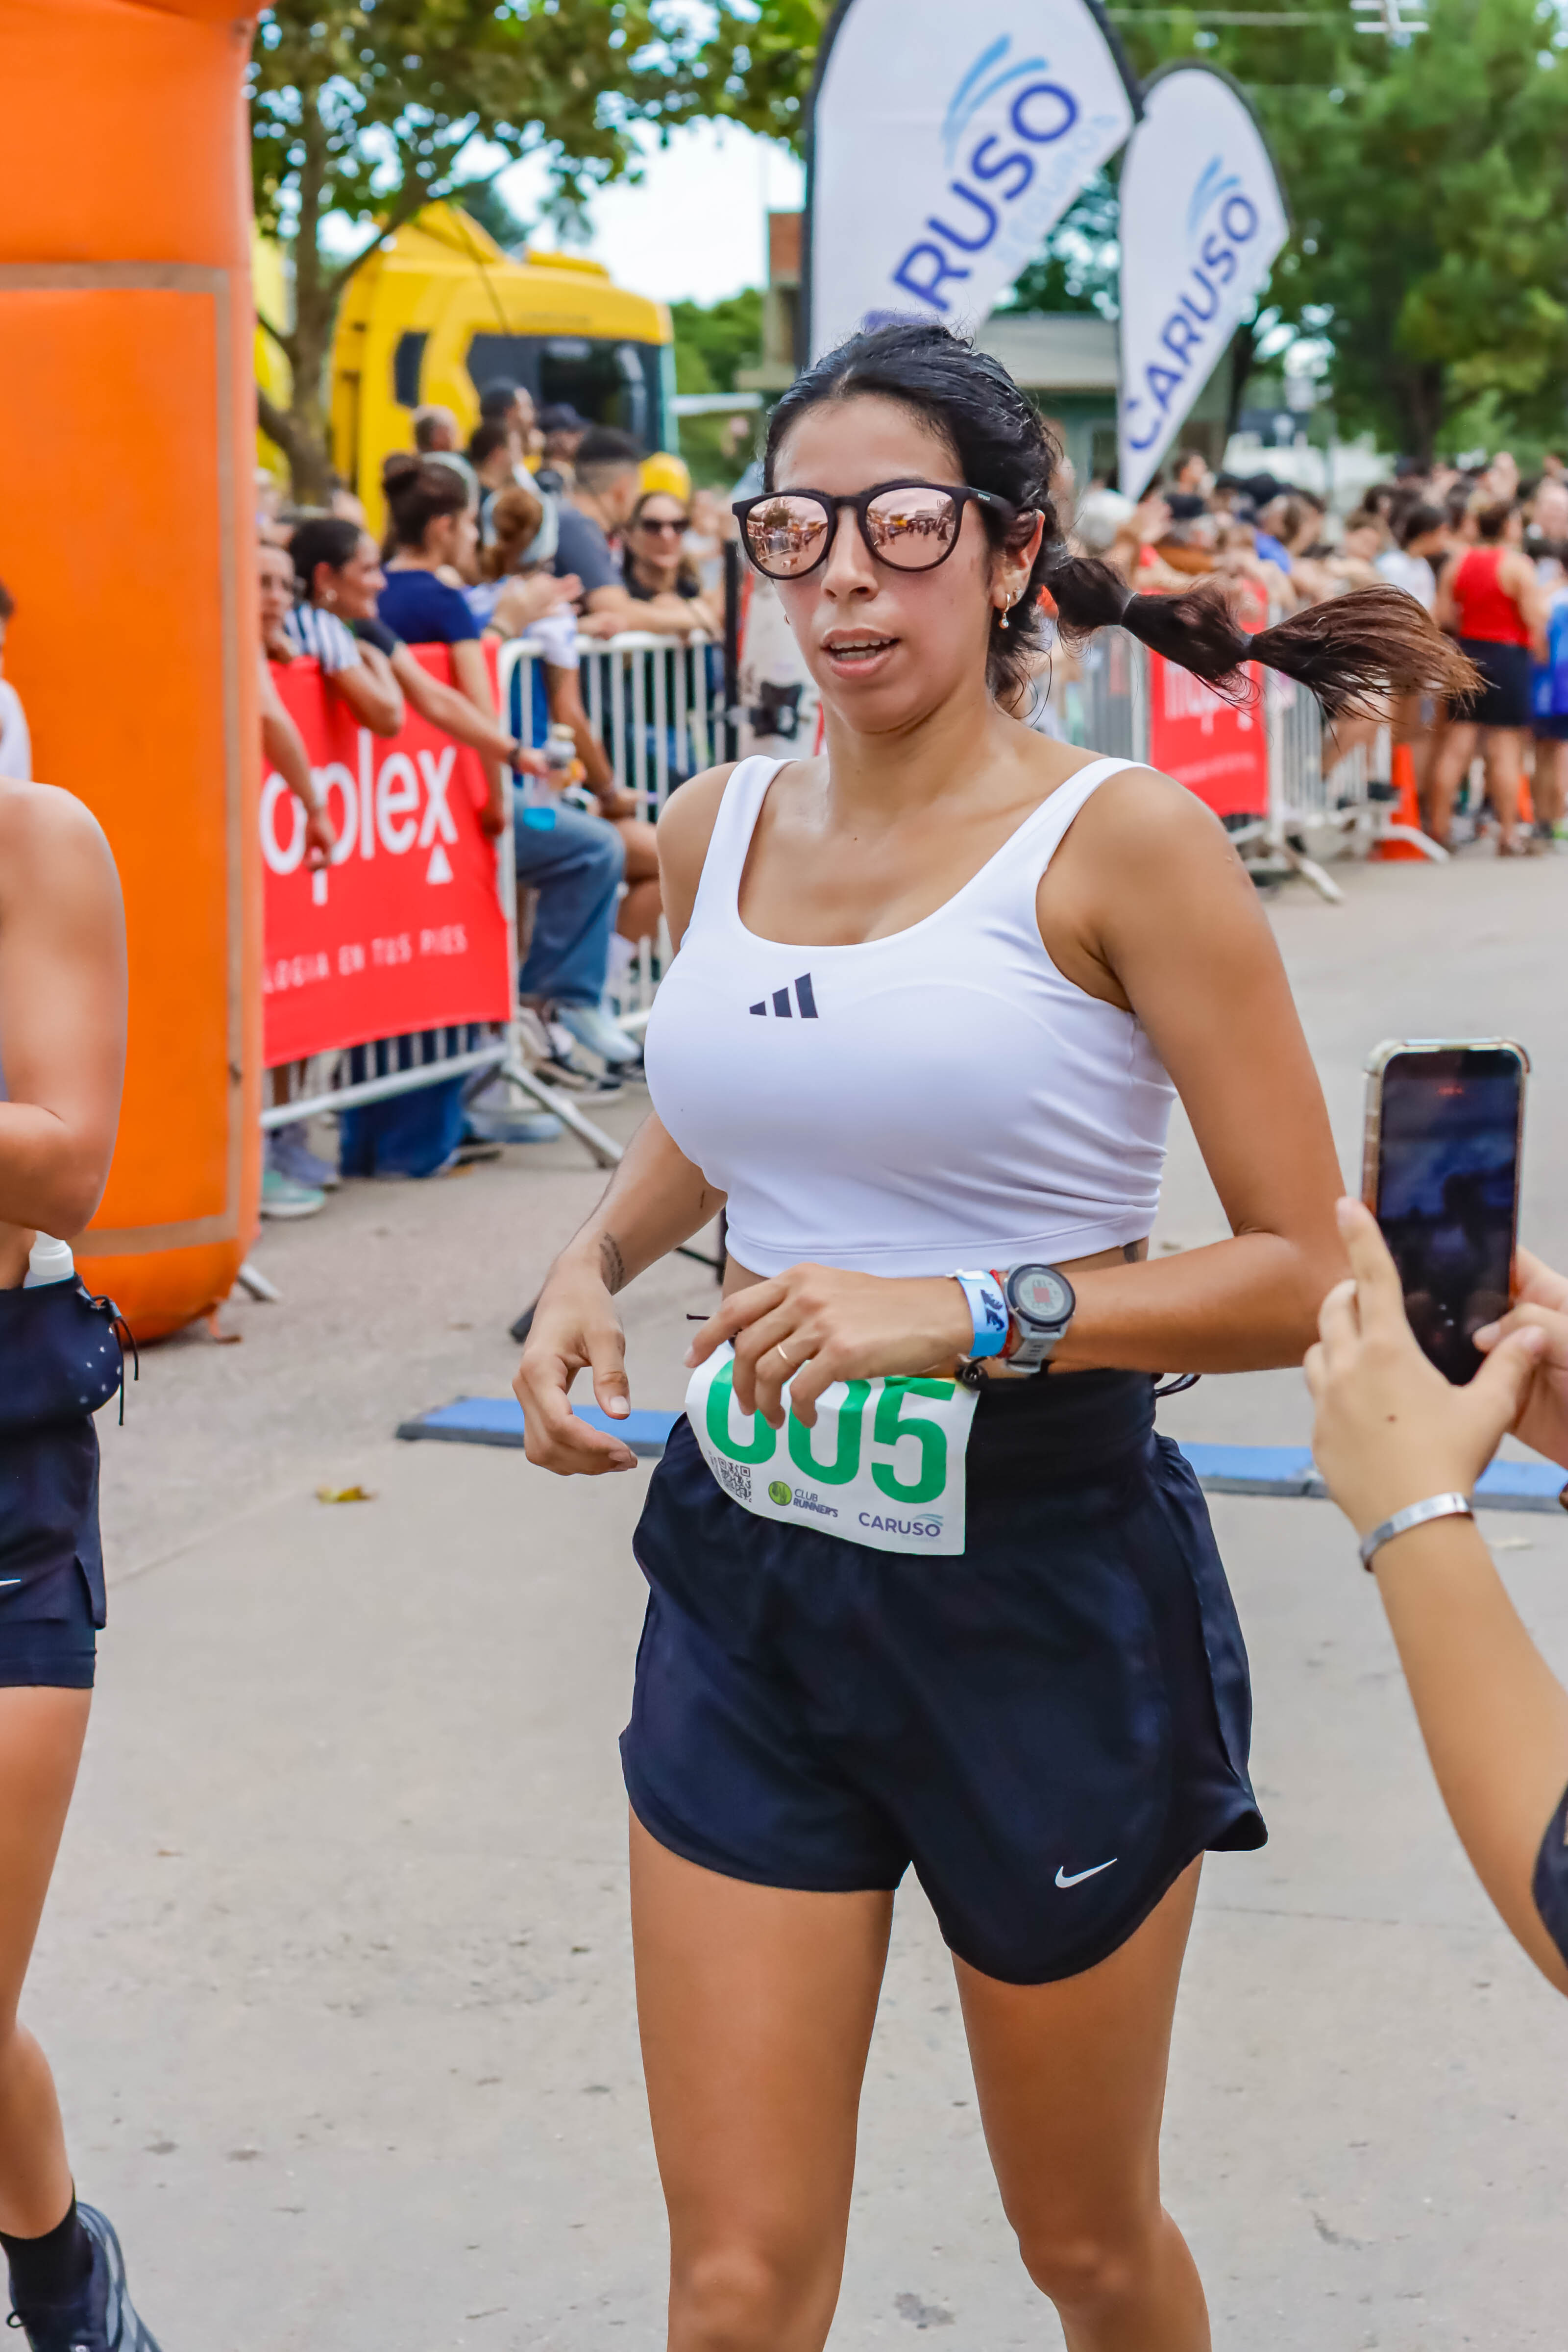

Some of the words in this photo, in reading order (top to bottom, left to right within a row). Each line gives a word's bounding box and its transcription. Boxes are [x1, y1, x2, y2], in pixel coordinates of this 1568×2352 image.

[865, 83, 1079, 327] RUSO
[1125, 195, 1258, 450] CARUSO
[707, 1359, 955, 1503] 005
[793, 1498, 839, 1518] RUNNER'S
[794, 1489, 818, 1502] CLUB
[858, 1512, 941, 1537] CARUSO
